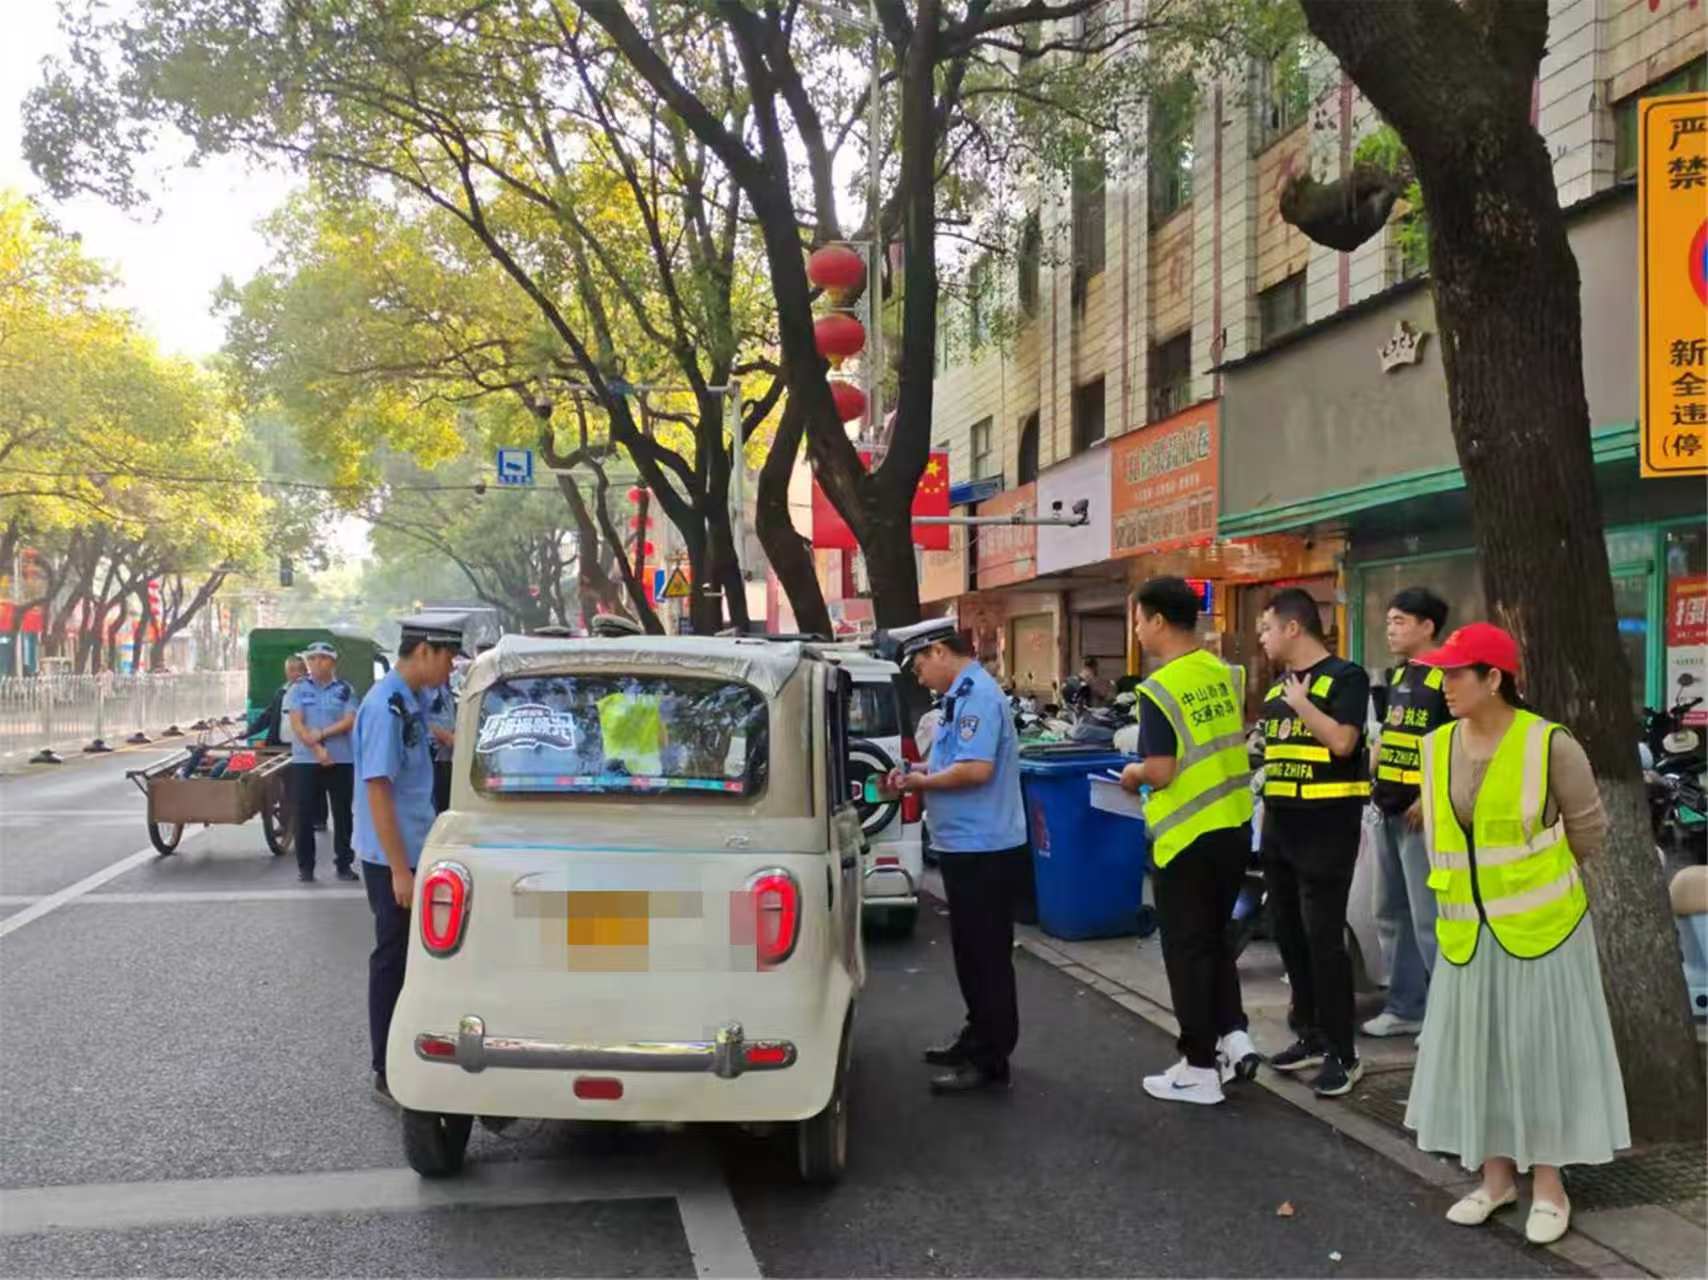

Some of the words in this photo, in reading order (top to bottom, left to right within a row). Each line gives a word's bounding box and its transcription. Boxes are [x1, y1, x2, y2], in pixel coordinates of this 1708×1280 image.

[1668, 115, 1708, 152] 严
[1667, 154, 1708, 190] 禁
[1669, 338, 1708, 367] 新
[1669, 371, 1708, 398] 全
